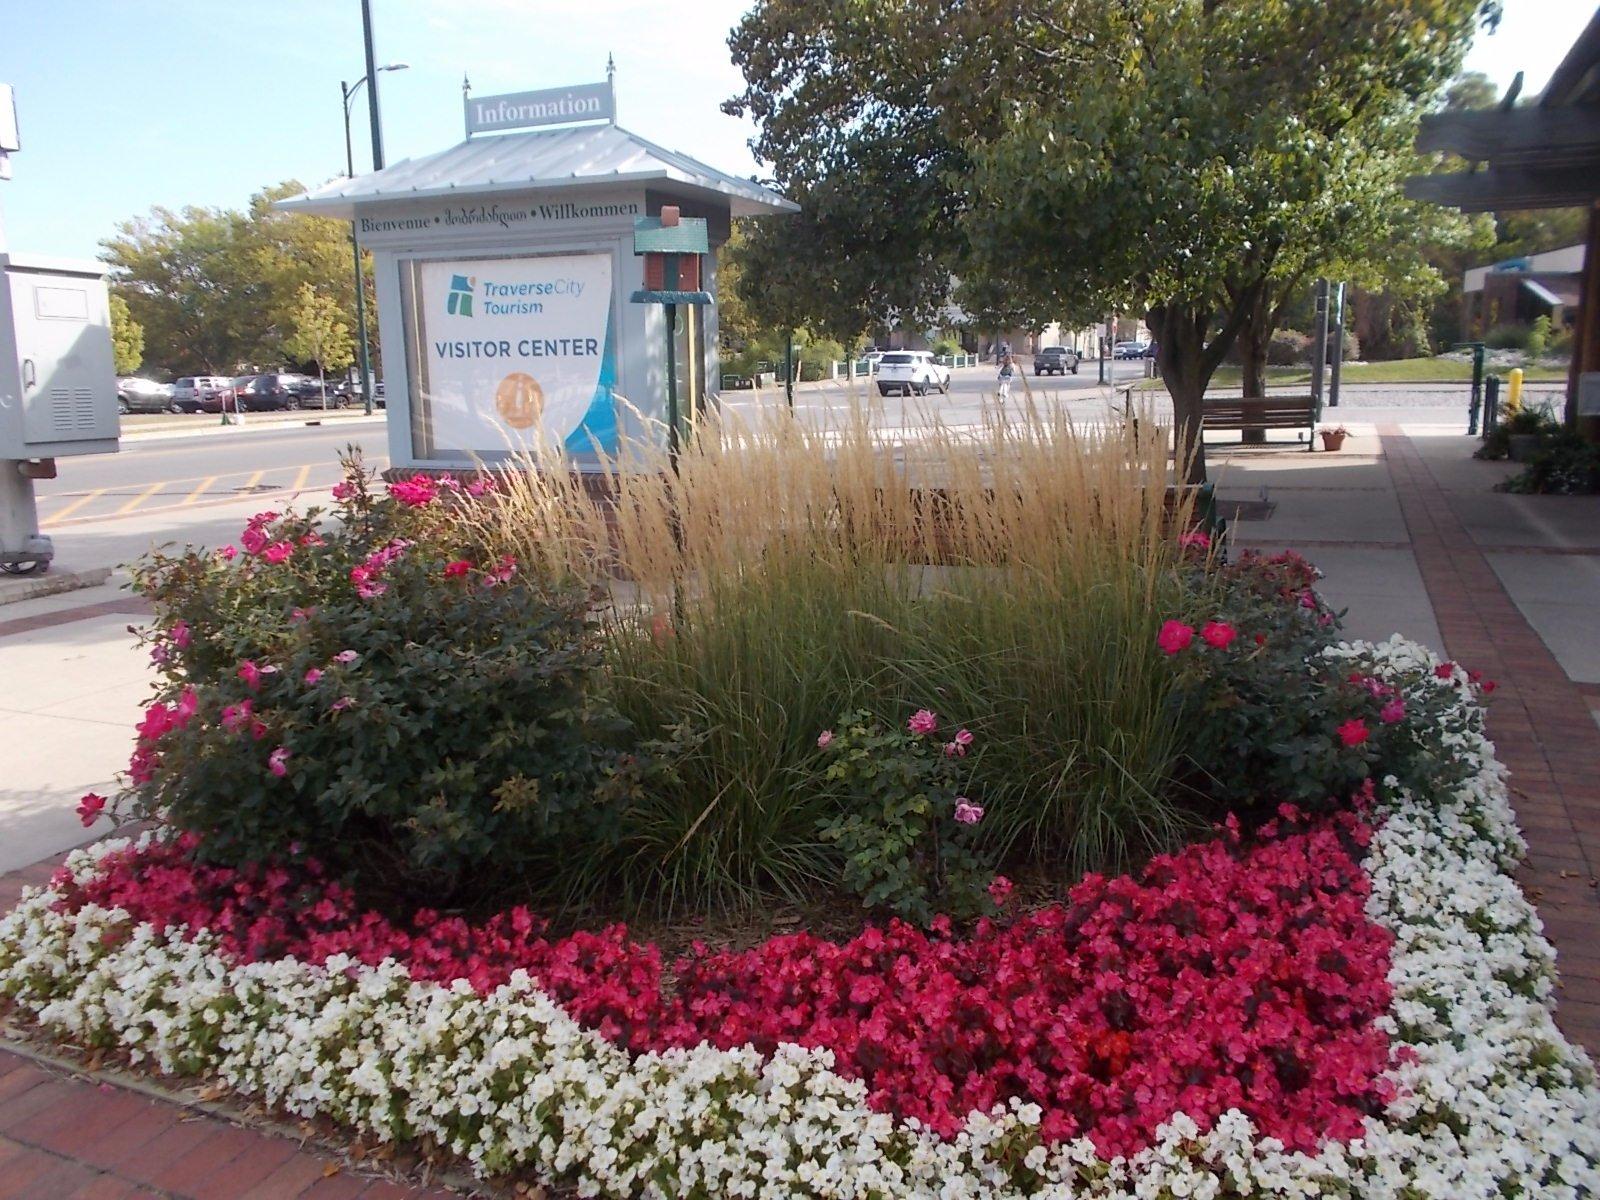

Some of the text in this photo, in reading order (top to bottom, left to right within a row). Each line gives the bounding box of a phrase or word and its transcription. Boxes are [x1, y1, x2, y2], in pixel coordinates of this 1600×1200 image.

[476, 93, 601, 125] Information
[361, 217, 431, 232] Bienvenue
[539, 202, 639, 220] Willkommen
[484, 301, 544, 315] Tourism
[436, 338, 598, 358] VISITOR CENTER
